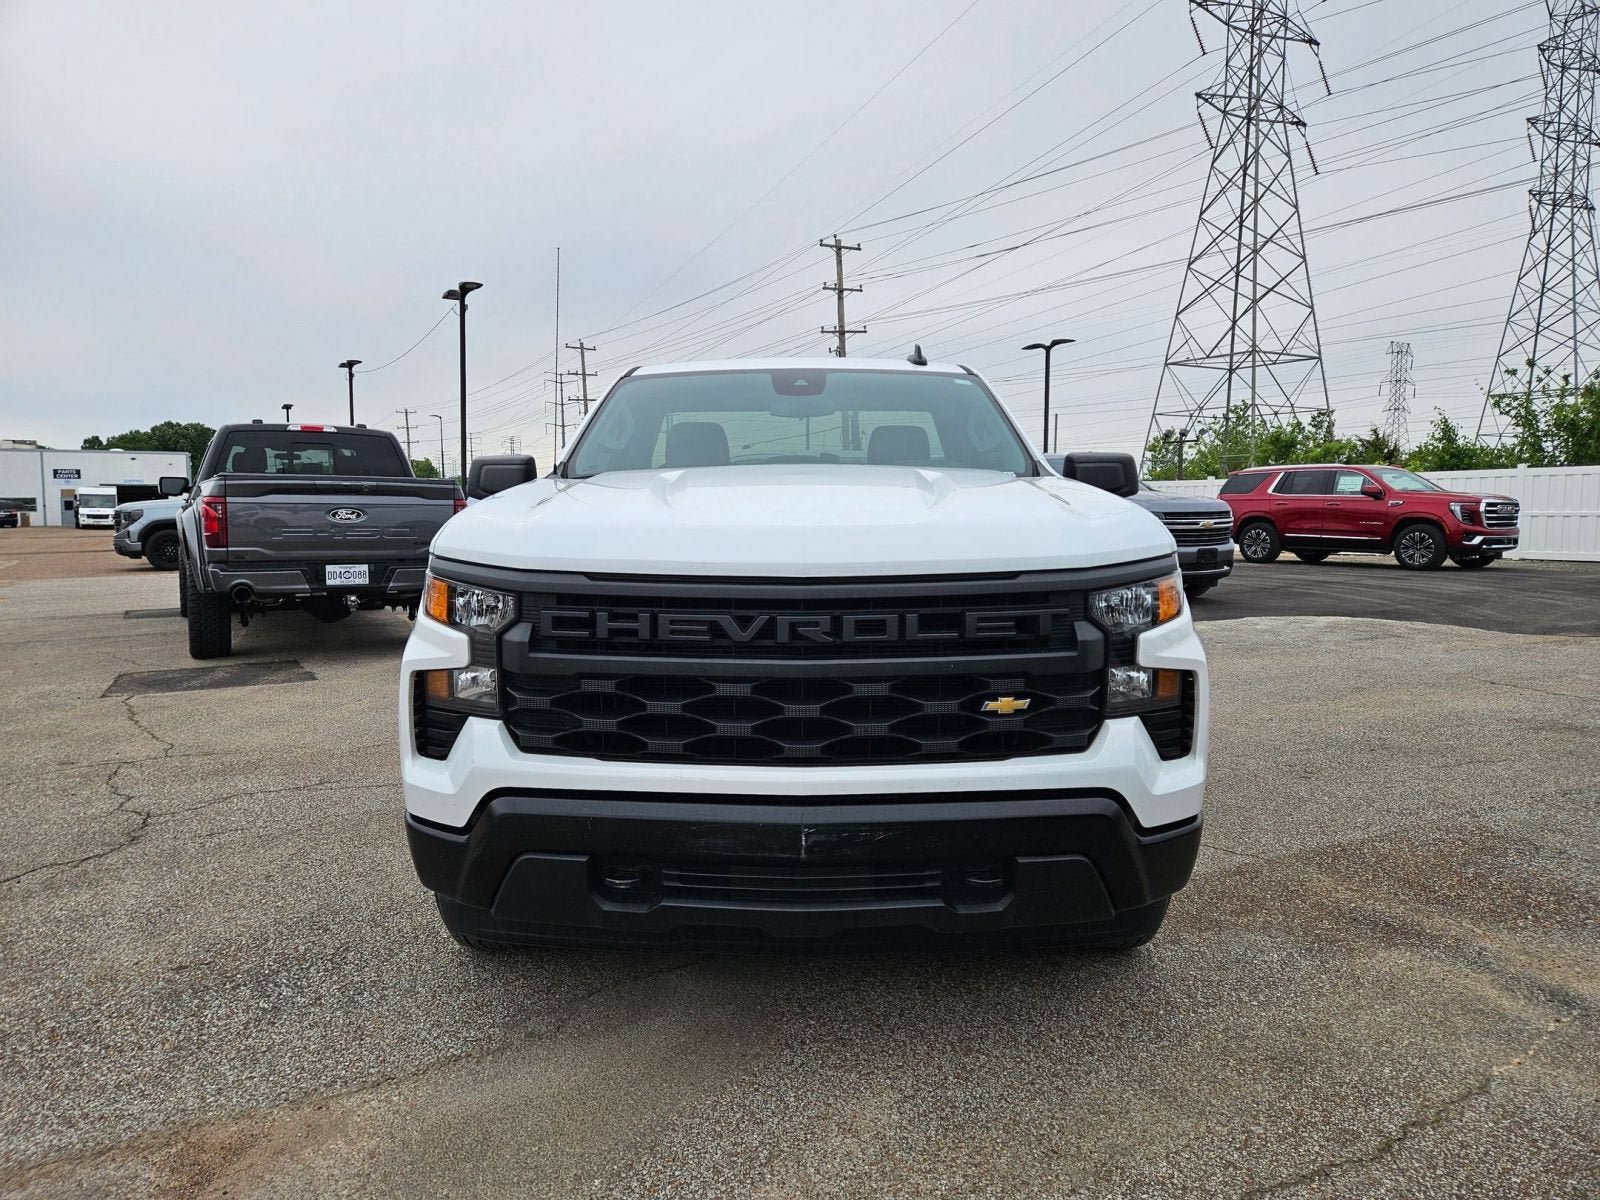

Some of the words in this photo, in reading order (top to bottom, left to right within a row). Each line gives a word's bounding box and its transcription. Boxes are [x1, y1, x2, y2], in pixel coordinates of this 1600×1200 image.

[335, 510, 358, 520] Ford
[271, 527, 418, 541] F-150
[540, 608, 1070, 644] CHEVROLET
